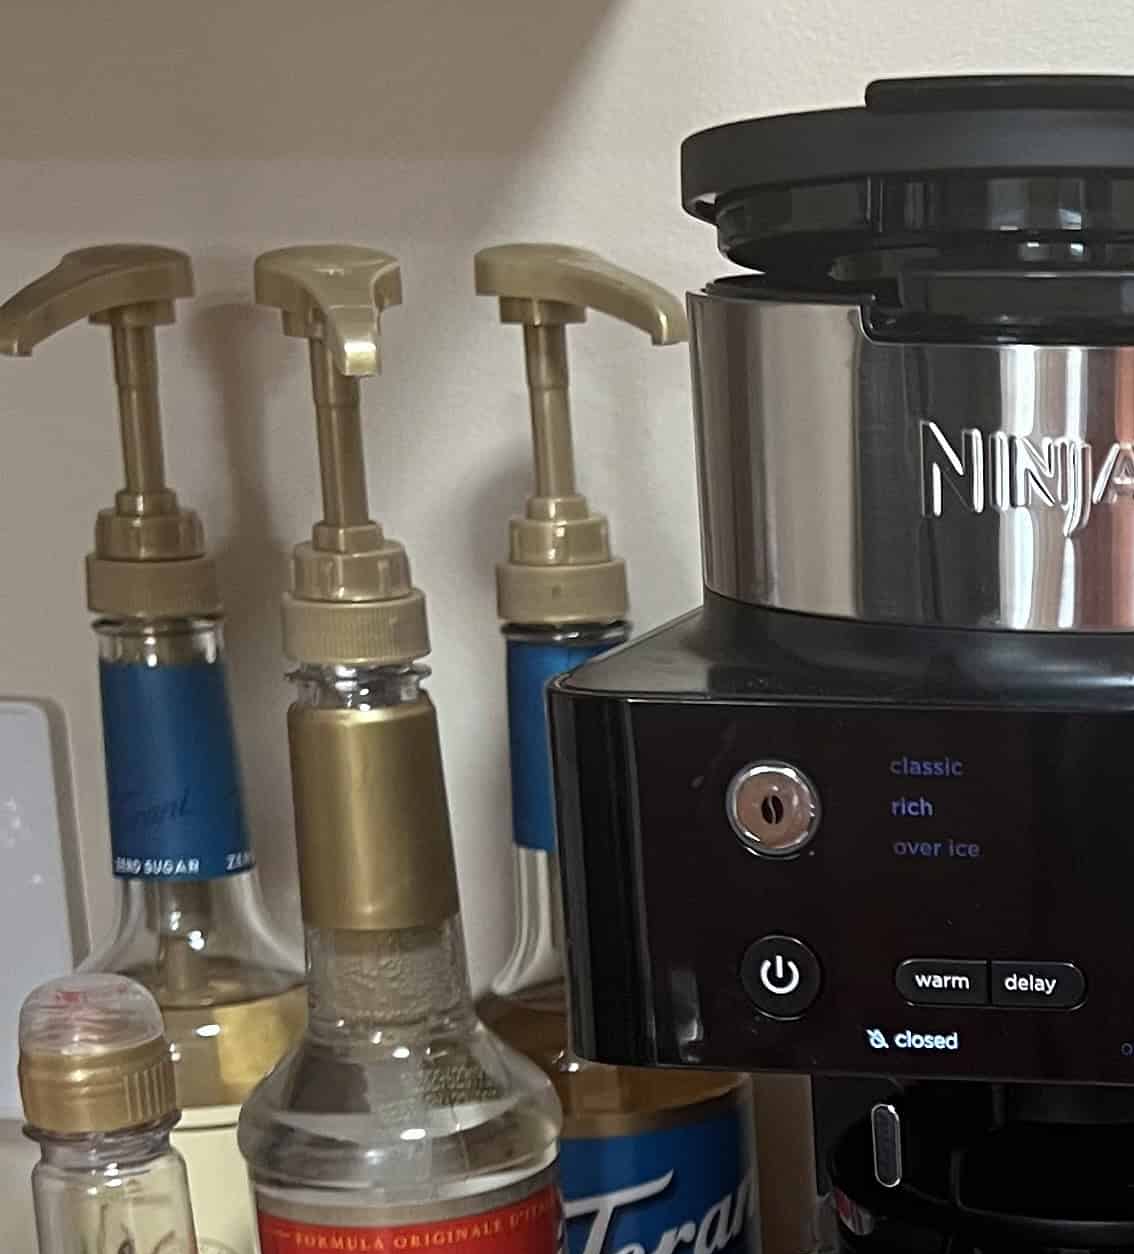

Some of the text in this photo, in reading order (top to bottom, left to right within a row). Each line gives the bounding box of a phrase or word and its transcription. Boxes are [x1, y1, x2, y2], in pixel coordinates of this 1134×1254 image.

[889, 756, 965, 777] classic
[891, 796, 934, 816] rich
[894, 839, 980, 858] over ice
[915, 974, 970, 990] warm
[1004, 973, 1057, 995] delay
[894, 1030, 959, 1050] closed
[295, 1230, 385, 1250] FORMULA
